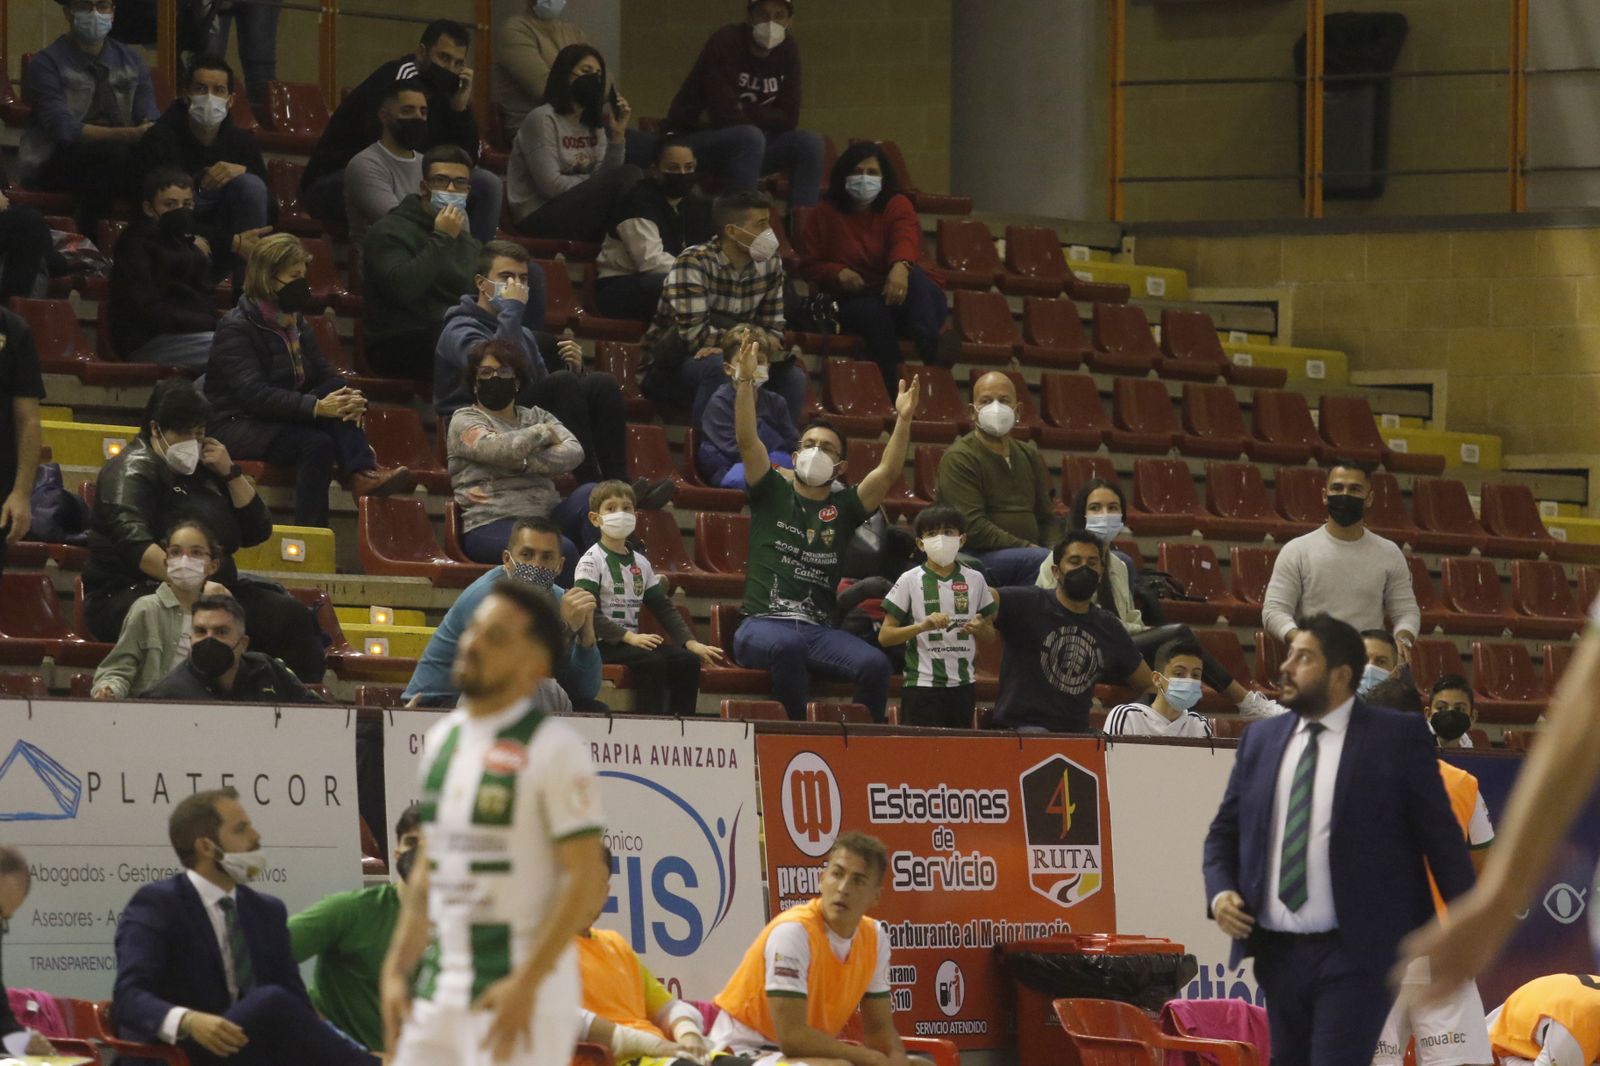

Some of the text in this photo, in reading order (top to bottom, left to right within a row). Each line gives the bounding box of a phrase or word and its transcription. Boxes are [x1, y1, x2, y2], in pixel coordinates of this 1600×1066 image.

[650, 745, 738, 769] AVANZADA
[868, 784, 1009, 823] Estaciones
[932, 827, 955, 851] de
[893, 852, 997, 891] Servicio
[1033, 849, 1098, 870] RUTA
[30, 864, 105, 886] Abogados
[777, 862, 829, 897] prem
[32, 909, 93, 928] Asesores
[963, 919, 977, 948] al
[30, 956, 117, 971] TRANSPARENCI
[915, 1020, 987, 1035] SERVICIO ATENDIDO
